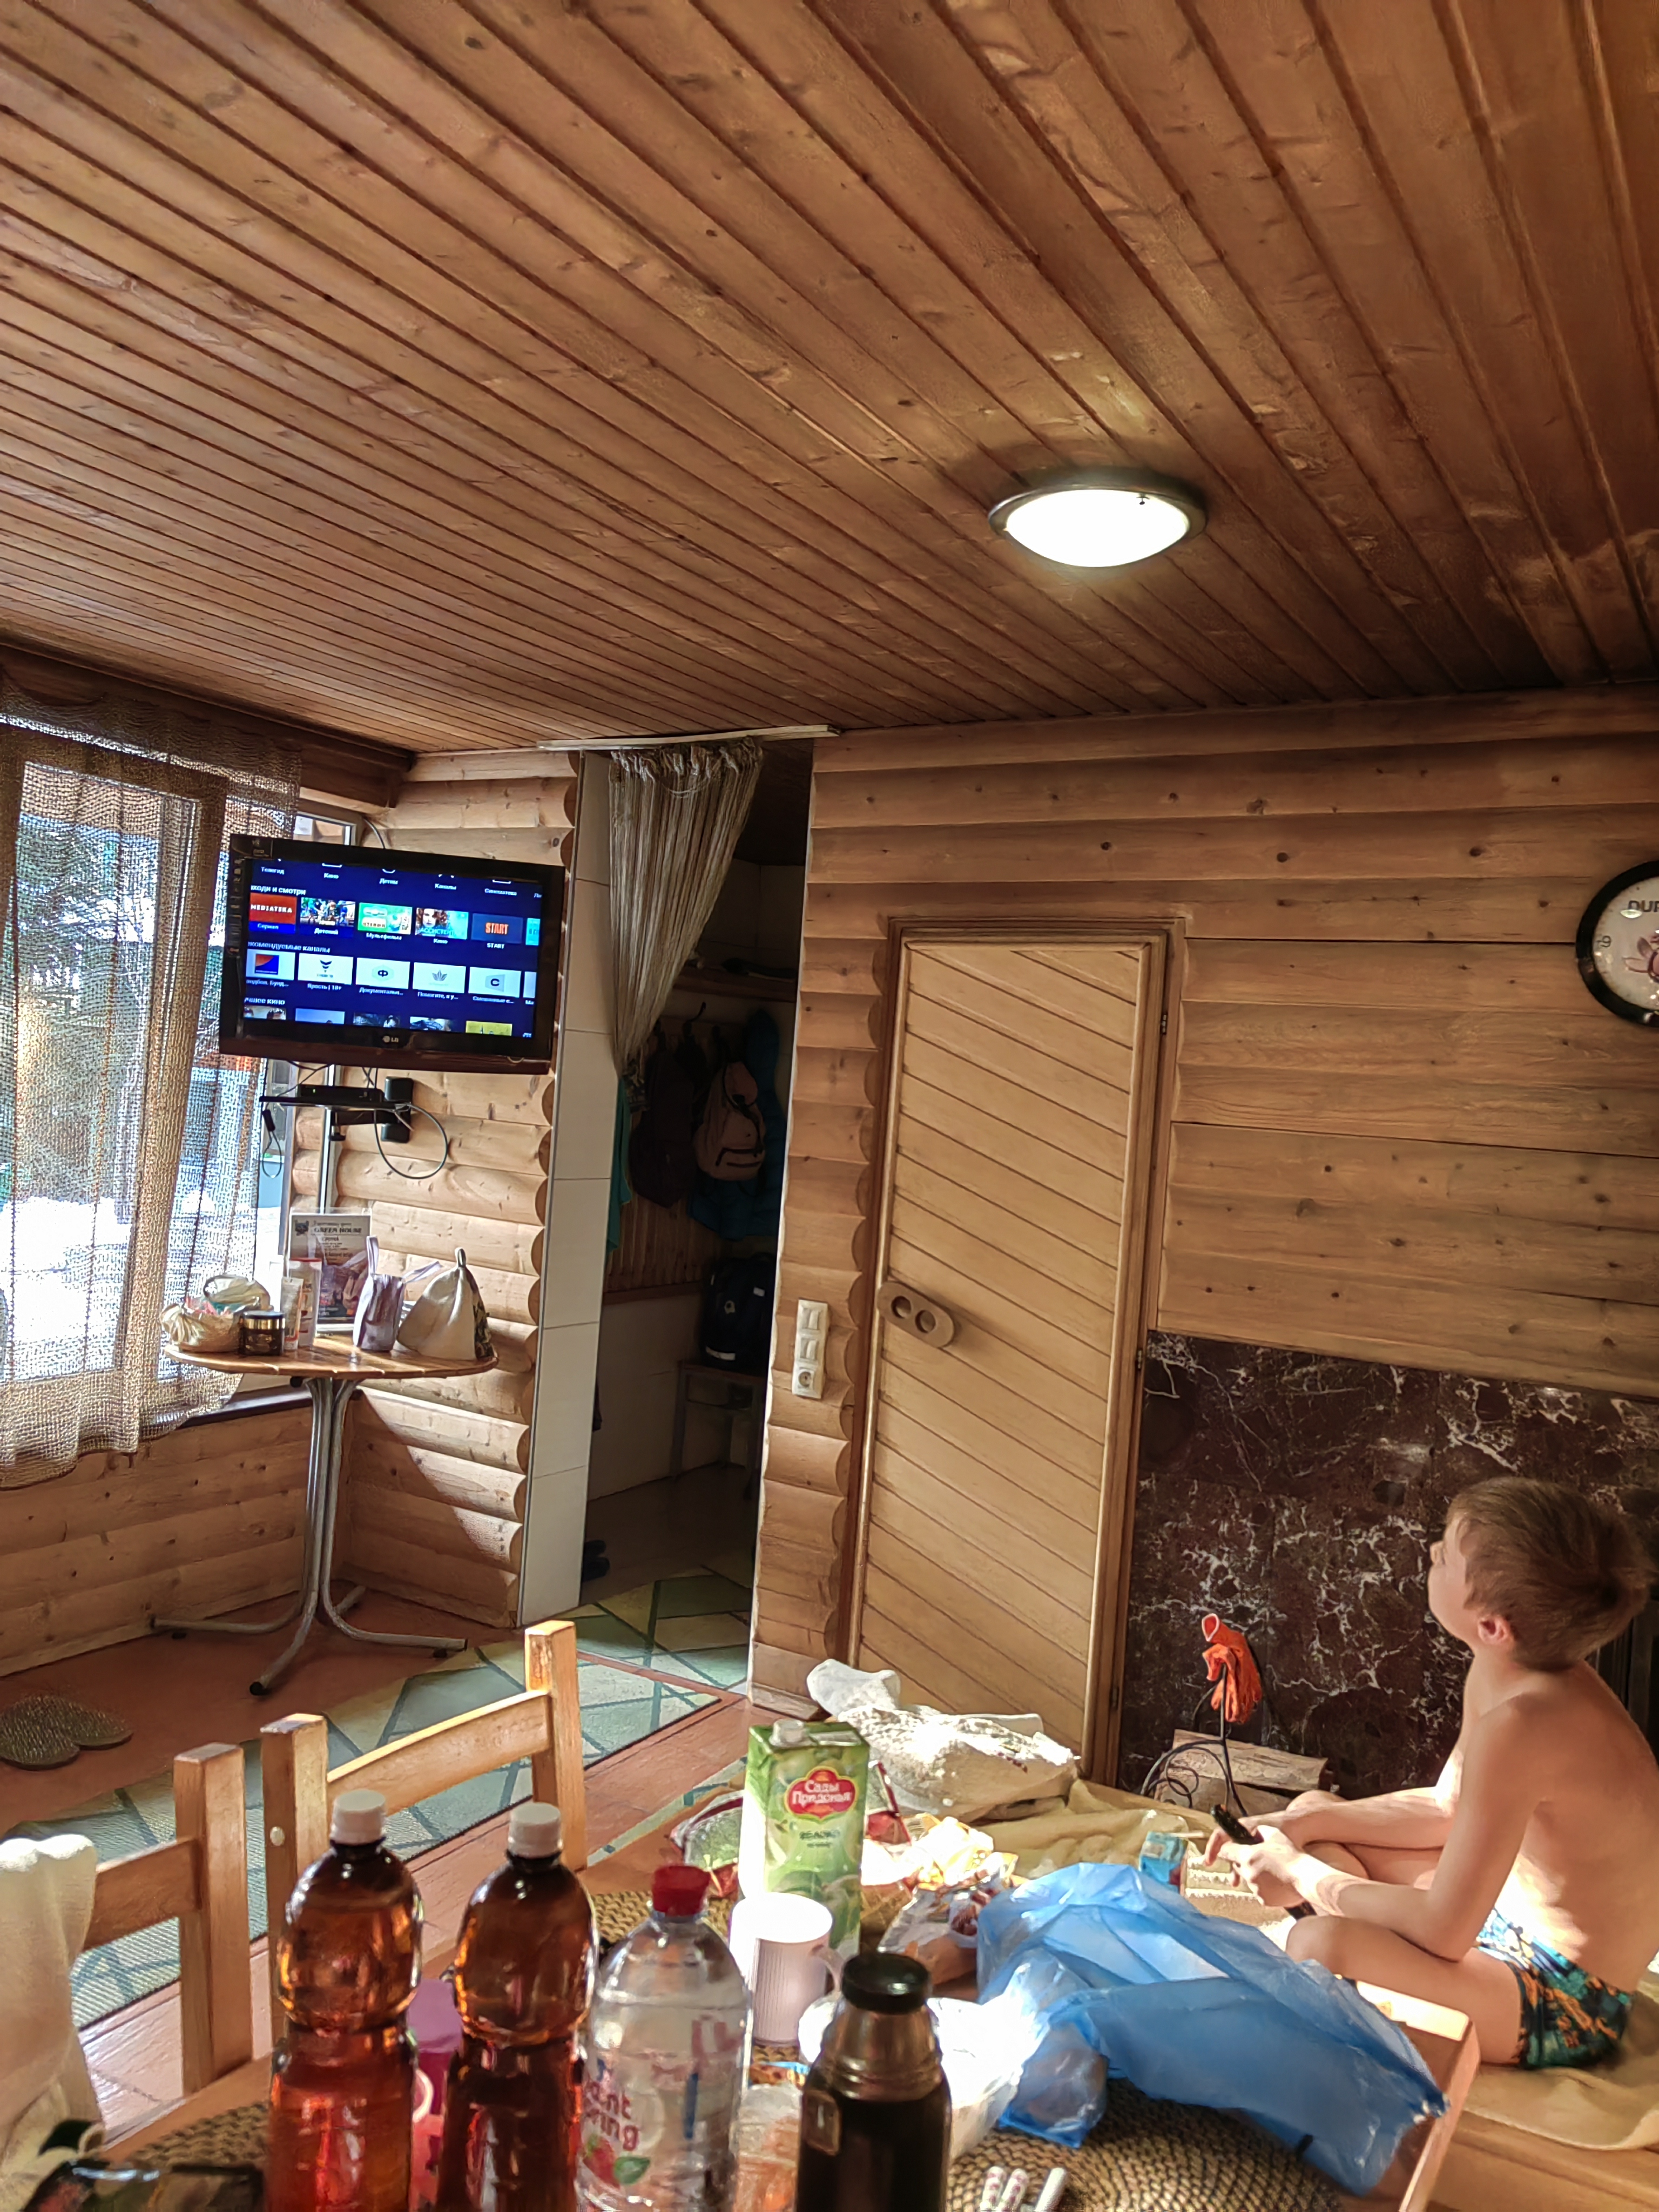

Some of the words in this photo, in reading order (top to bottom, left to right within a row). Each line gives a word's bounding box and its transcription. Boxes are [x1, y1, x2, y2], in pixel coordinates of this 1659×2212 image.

[278, 887, 307, 896] смотри
[485, 922, 509, 935] START
[1600, 935, 1611, 948] 9
[805, 1779, 840, 1792] Сады
[792, 1791, 852, 1808] Придонья
